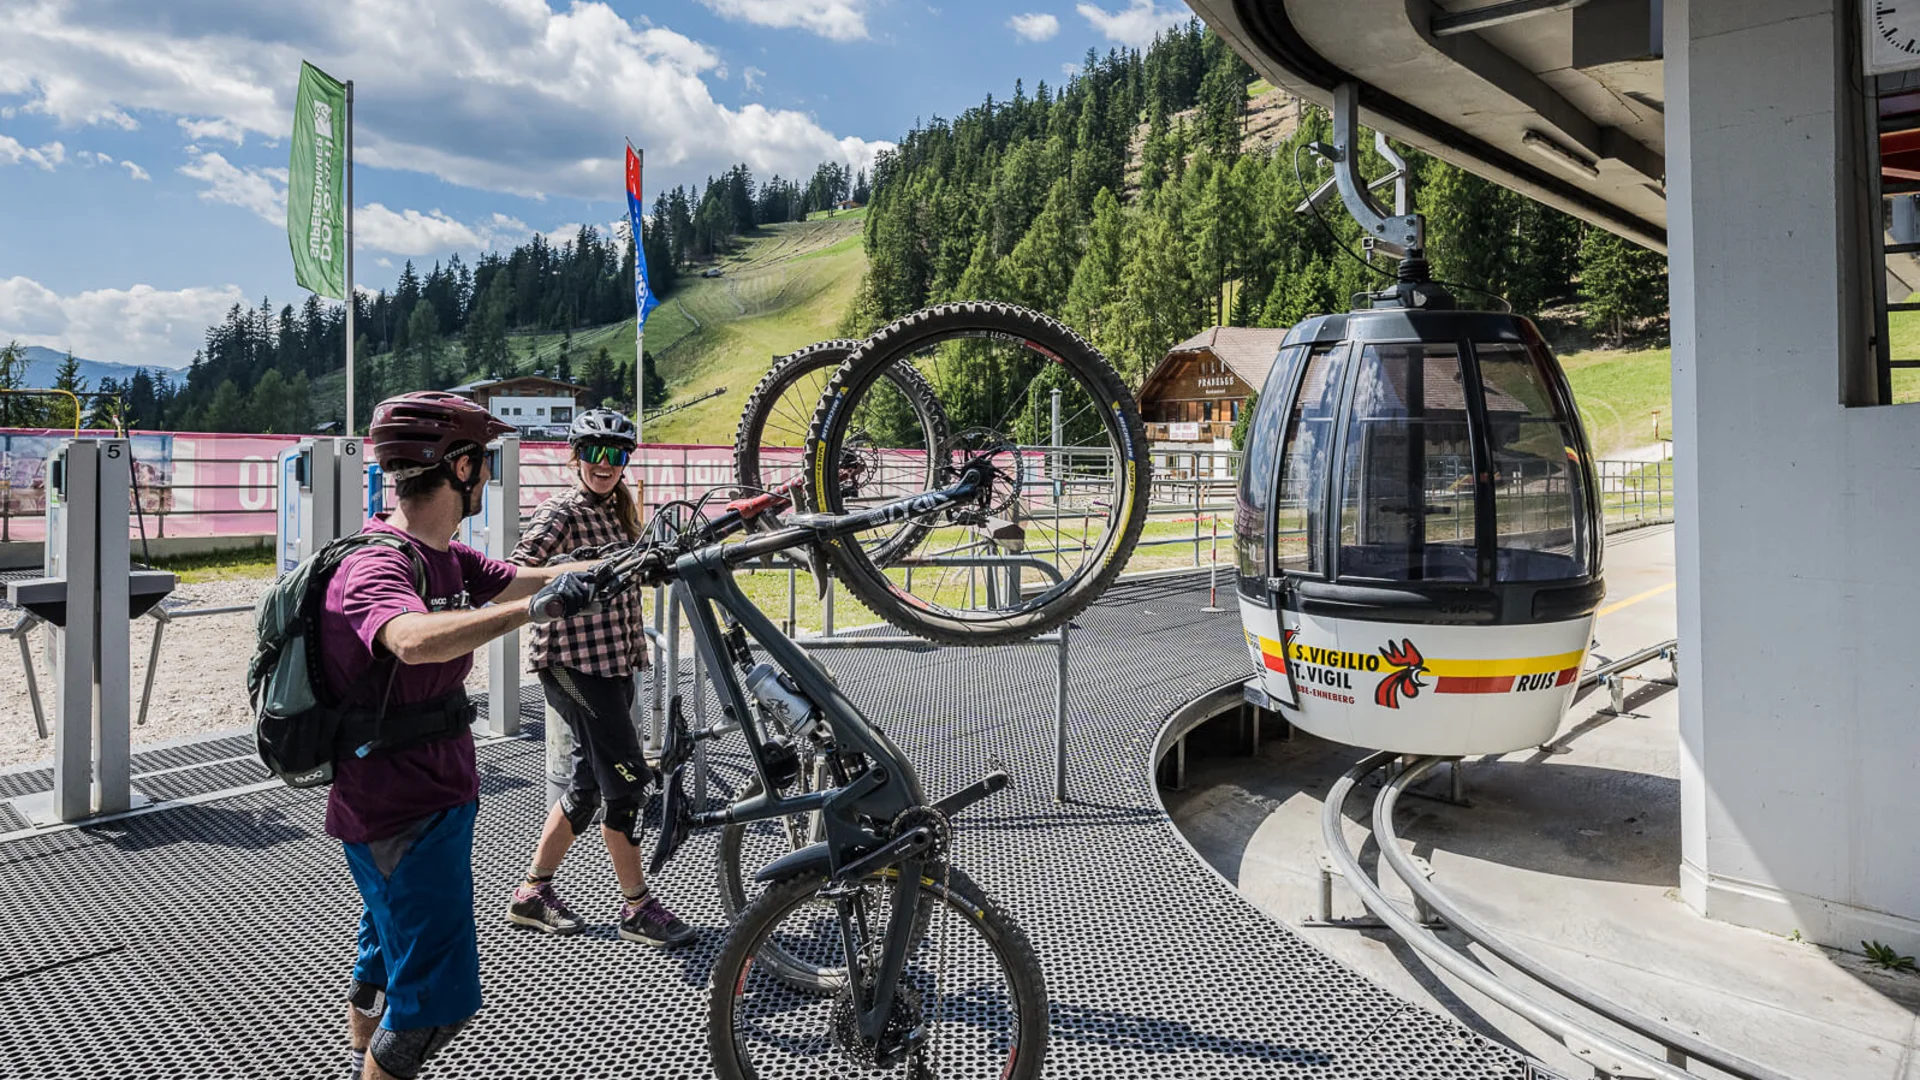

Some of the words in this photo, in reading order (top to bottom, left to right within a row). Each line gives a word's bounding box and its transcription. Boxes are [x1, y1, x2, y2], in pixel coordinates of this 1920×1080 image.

[821, 399, 840, 440] MICHELIN
[1119, 415, 1134, 458] MICHELIN
[107, 444, 121, 459] 5
[345, 442, 356, 456] 6
[1516, 671, 1556, 692] RUIS
